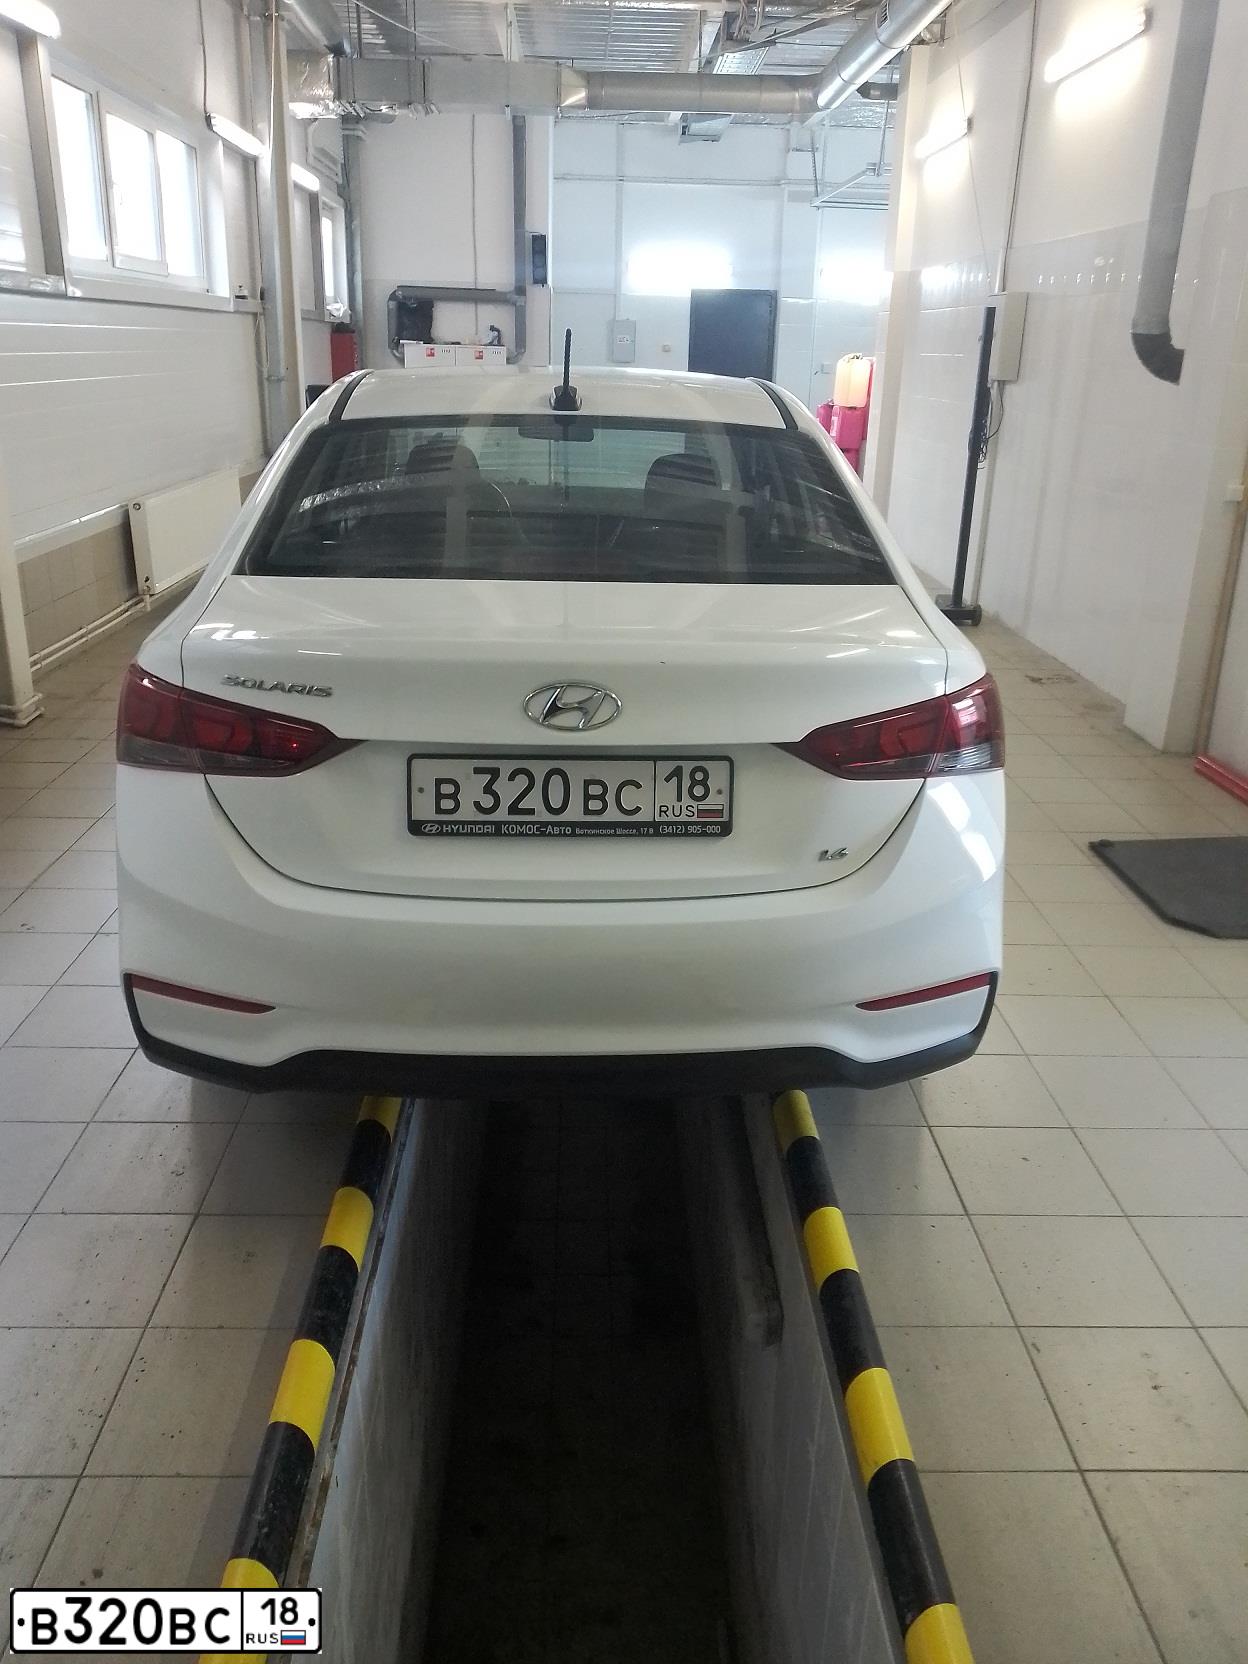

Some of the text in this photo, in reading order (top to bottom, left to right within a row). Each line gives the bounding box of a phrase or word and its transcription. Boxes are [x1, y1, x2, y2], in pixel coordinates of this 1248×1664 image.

[222, 674, 333, 698] SOLARIS
[663, 765, 711, 802] 18
[658, 804, 695, 818] RUS
[442, 824, 495, 833] HYUNDAI
[659, 825, 685, 834] (3412)
[687, 825, 721, 834] 905-000
